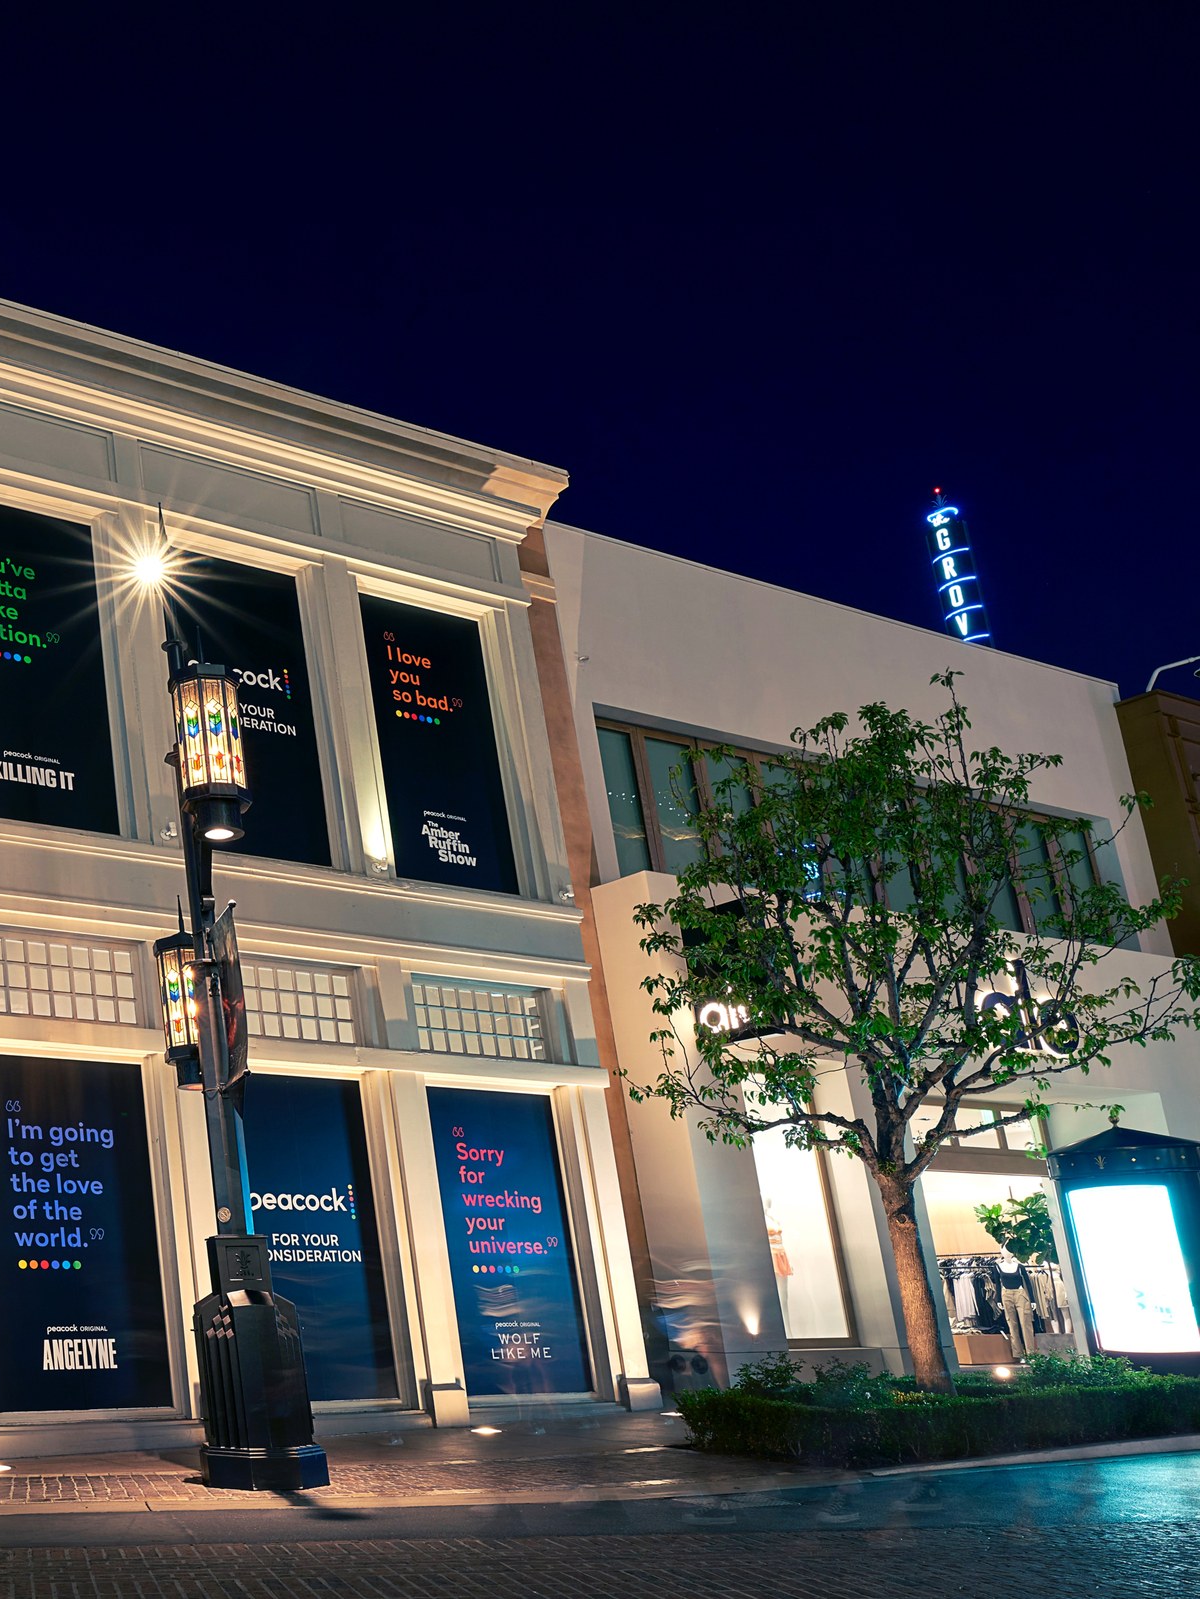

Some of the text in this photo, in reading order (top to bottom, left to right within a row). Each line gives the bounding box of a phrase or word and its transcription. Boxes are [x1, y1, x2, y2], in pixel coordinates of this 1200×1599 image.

[936, 528, 968, 636] GROV
[387, 645, 431, 669] I love
[389, 668, 420, 686] you
[392, 689, 412, 703] so
[239, 702, 275, 720] YOUR
[240, 717, 297, 736] ERATION
[3, 750, 60, 765] peacock ORIGINAL
[59, 770, 75, 791] IT
[423, 810, 446, 819] peacock
[421, 824, 460, 840] Amber
[427, 820, 439, 828] The
[428, 835, 470, 854] Ruffin
[438, 849, 477, 867] Show
[7, 1118, 114, 1148] I'm going
[8, 1147, 80, 1173] to get
[456, 1142, 504, 1167] Sorry
[10, 1172, 103, 1195] the love
[459, 1166, 485, 1184] for
[13, 1199, 82, 1221] of the
[462, 1190, 542, 1214] wrecking
[465, 1217, 505, 1235] your
[272, 1233, 339, 1247] FOR YOUR
[268, 1249, 362, 1262] ONSIDERATION
[47, 1324, 78, 1335] peacock
[495, 1321, 518, 1330] peacock
[498, 1333, 540, 1345] WOLF
[43, 1338, 118, 1370] ANGELYNE
[491, 1347, 552, 1359] LIKE ME
